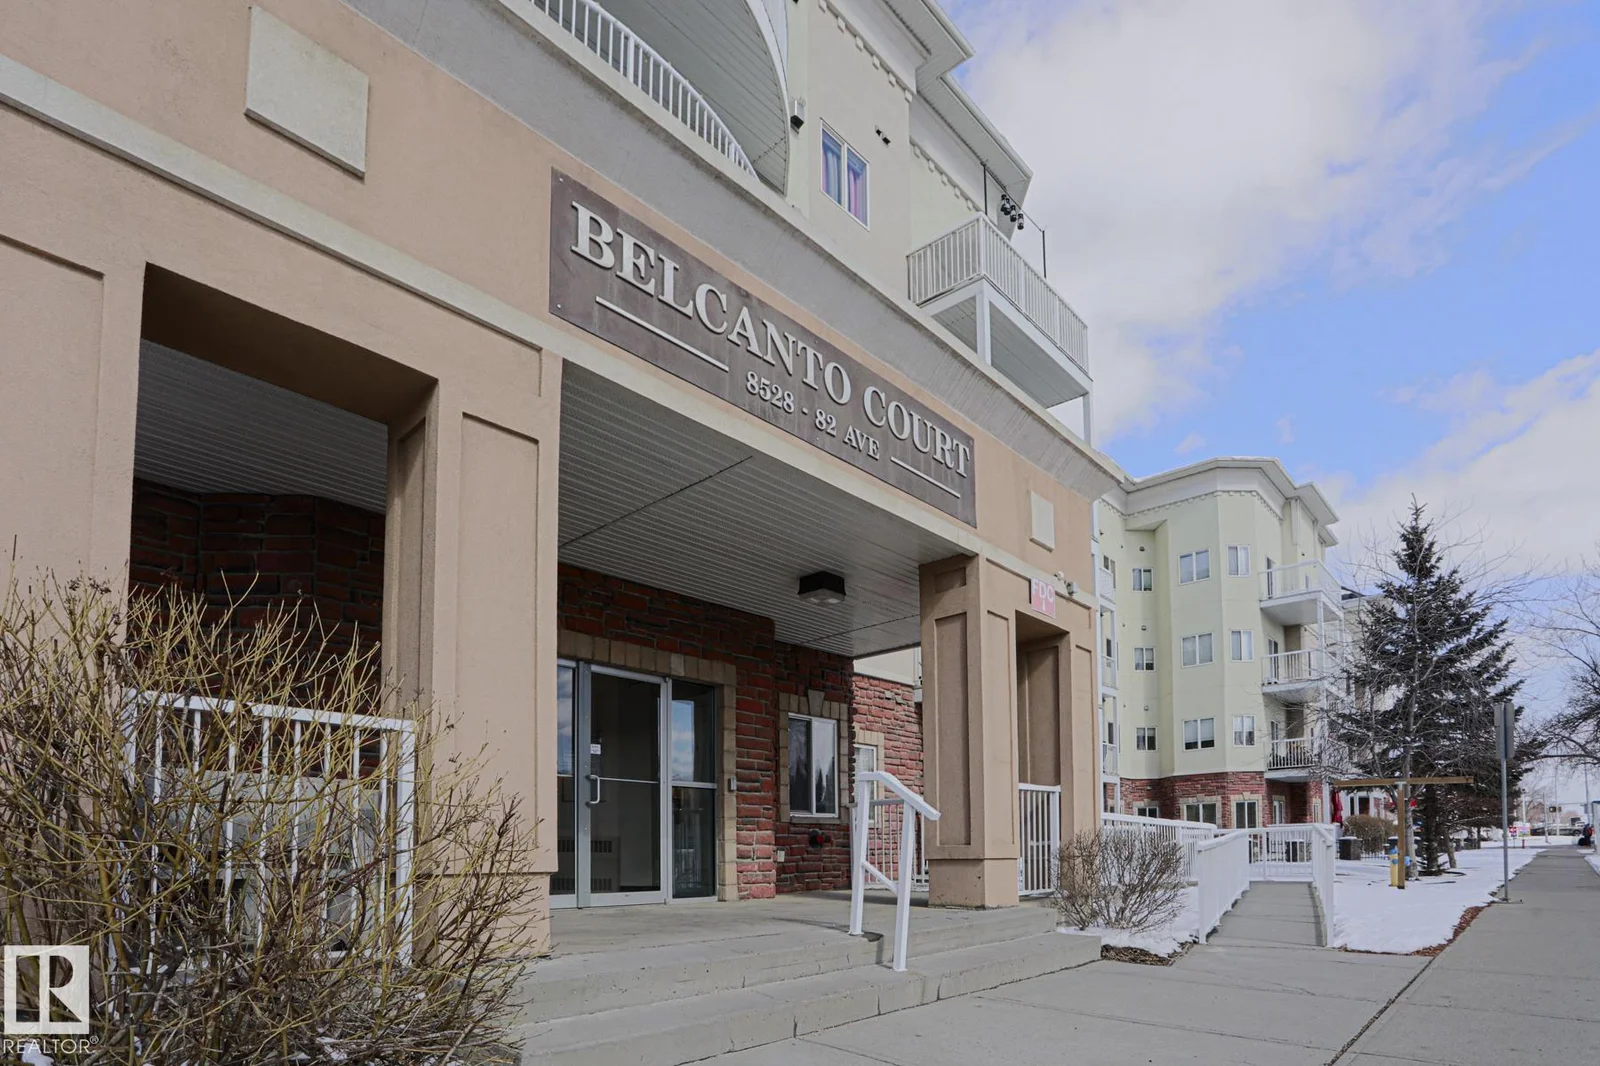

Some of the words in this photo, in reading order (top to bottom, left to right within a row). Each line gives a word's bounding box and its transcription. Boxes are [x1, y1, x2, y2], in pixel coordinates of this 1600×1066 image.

[571, 201, 852, 405] BELCANTO
[863, 386, 971, 478] COURT
[746, 371, 795, 414] 8528
[815, 409, 837, 437] 82
[843, 425, 880, 460] AVE
[1032, 578, 1055, 603] FDC
